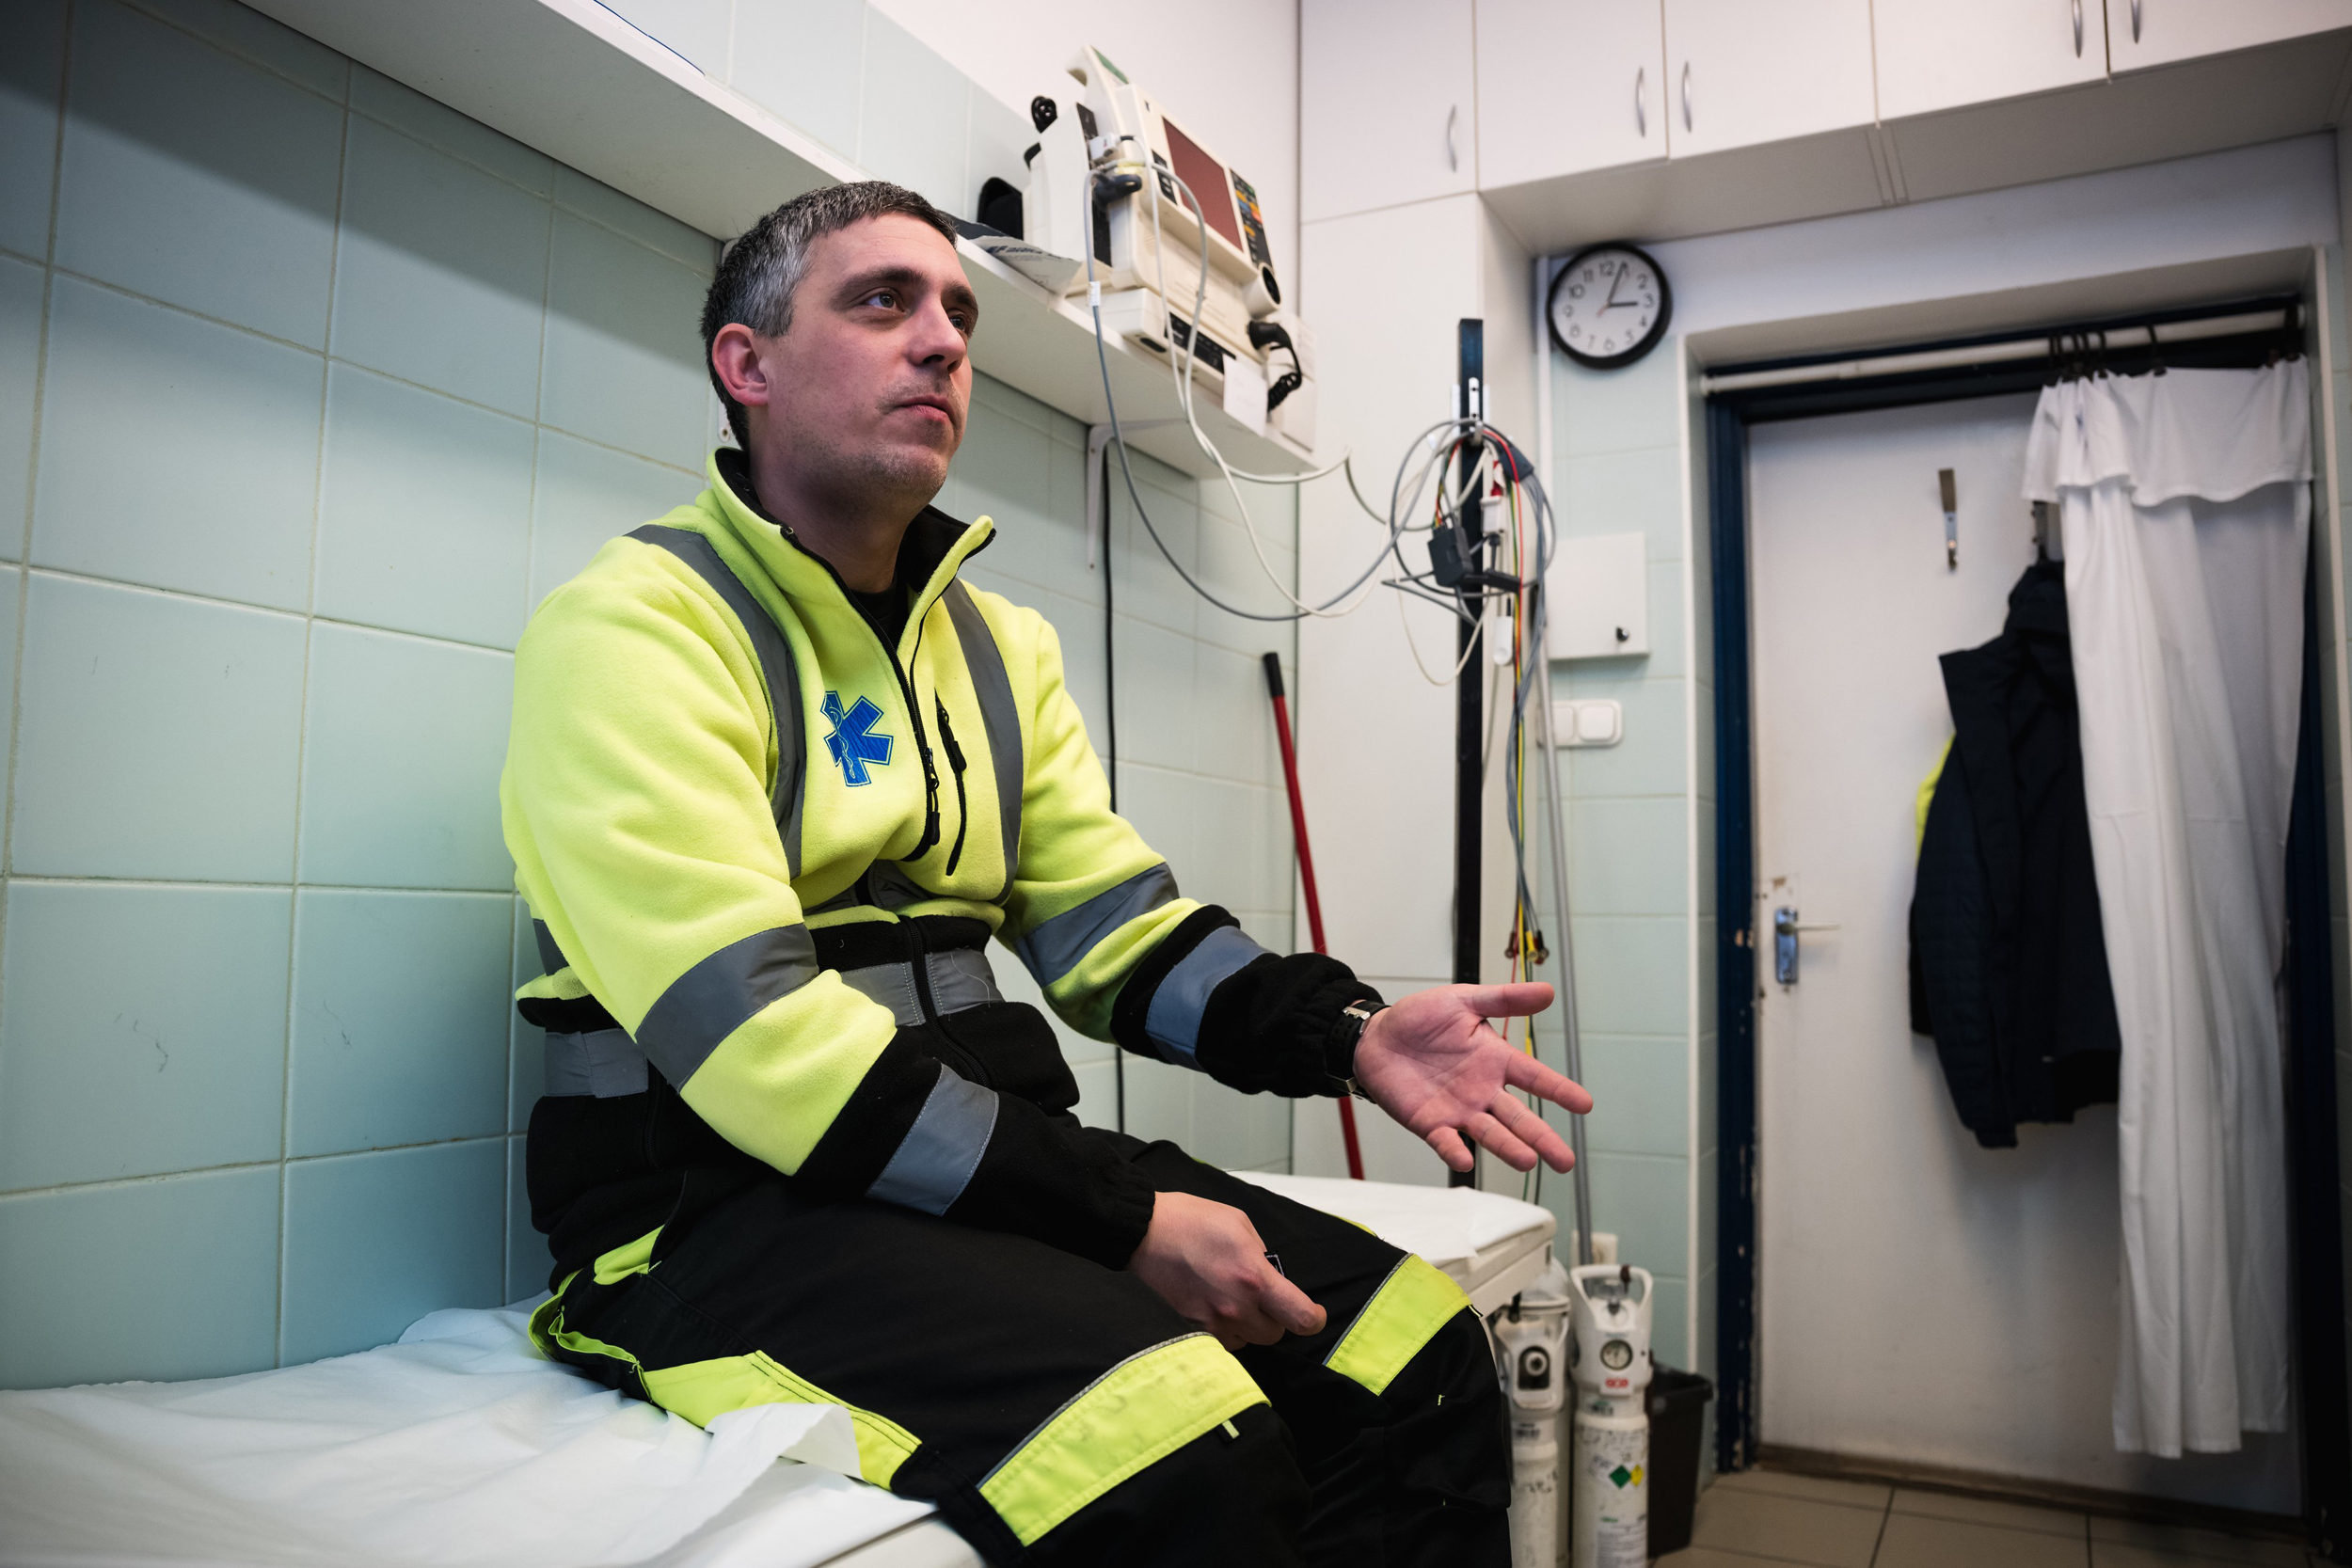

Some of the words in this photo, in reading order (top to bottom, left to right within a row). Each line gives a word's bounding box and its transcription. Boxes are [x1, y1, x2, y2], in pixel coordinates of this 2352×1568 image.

[1599, 260, 1615, 277] 12
[1637, 273, 1647, 290] 2
[1568, 282, 1586, 299] 10
[1644, 293, 1655, 309] 3
[1562, 304, 1575, 319] 9
[1639, 314, 1647, 327] 4
[1625, 329, 1635, 345] 5
